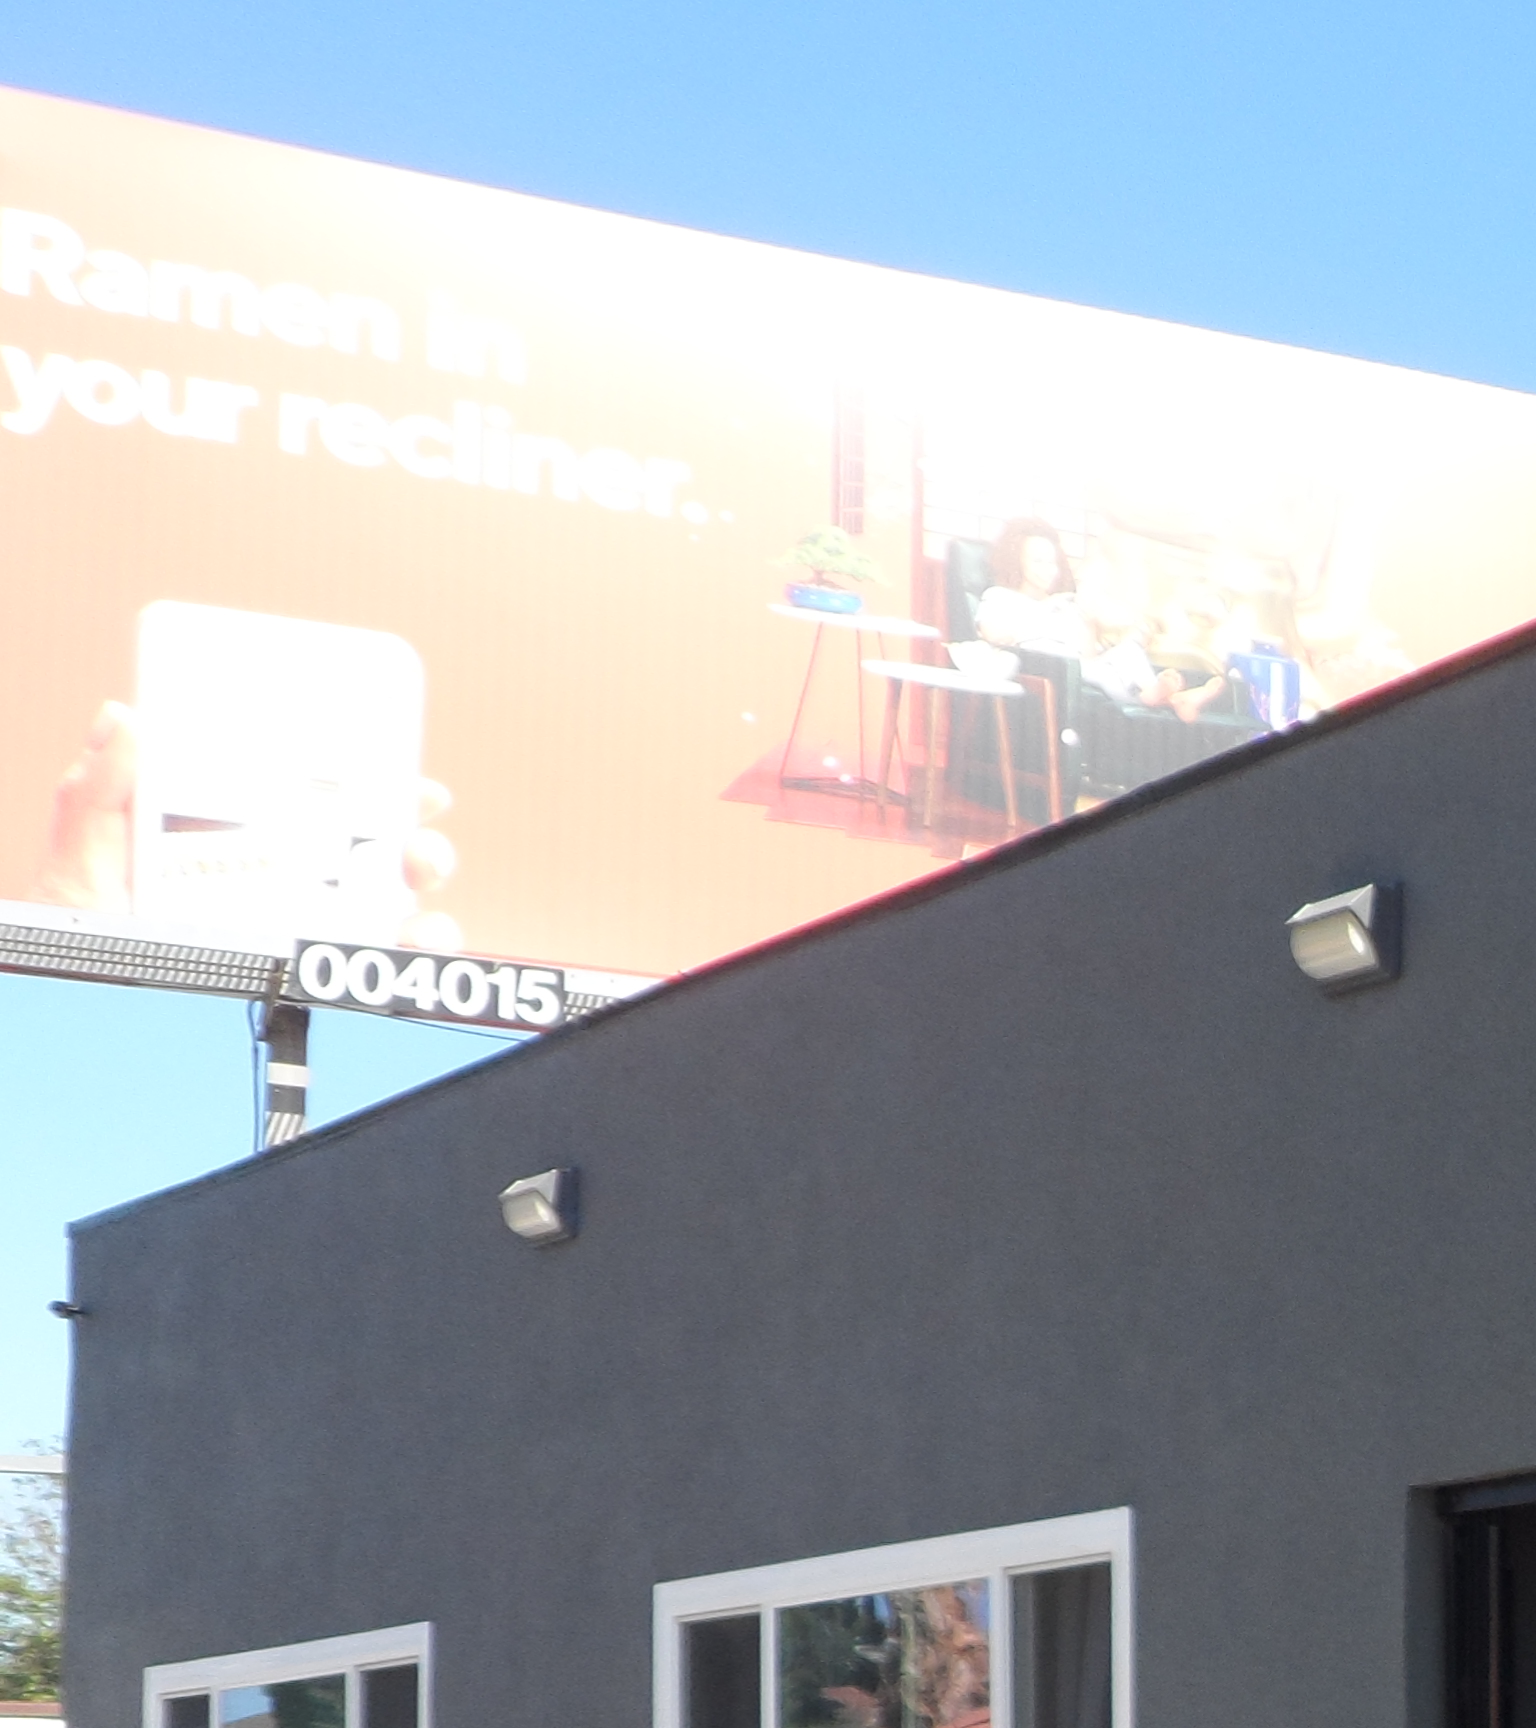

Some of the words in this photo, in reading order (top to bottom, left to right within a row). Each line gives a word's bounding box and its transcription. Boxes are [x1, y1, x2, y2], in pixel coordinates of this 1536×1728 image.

[0, 206, 400, 362] Ramen
[0, 344, 258, 443] your
[299, 943, 561, 1025] 004015
